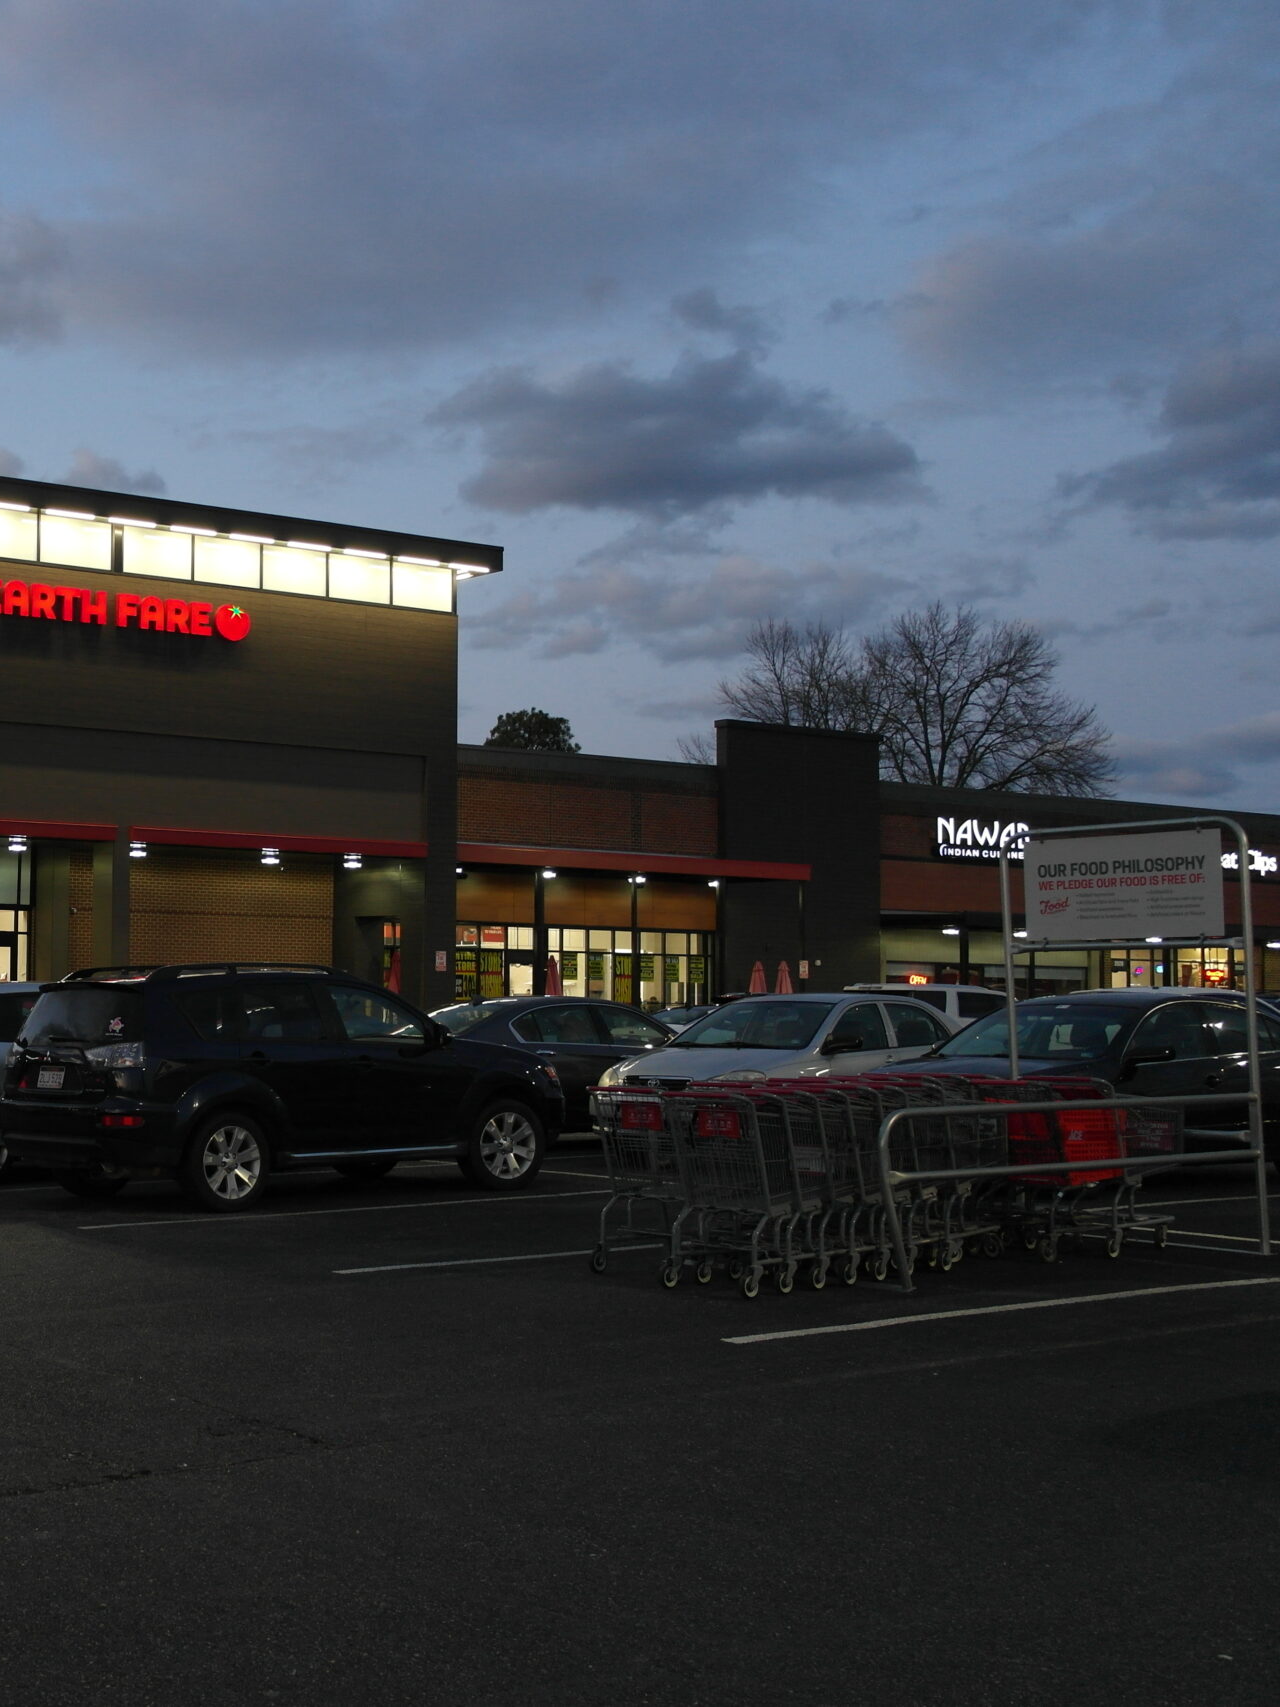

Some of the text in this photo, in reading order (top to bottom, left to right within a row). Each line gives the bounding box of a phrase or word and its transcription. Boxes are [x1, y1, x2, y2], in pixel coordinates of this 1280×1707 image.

[116, 593, 213, 636] FARE
[943, 848, 1025, 860] INDIAN CUIINE
[1037, 855, 1206, 878] OUR FOOD PHILOSOPHY
[1039, 880, 1055, 891] WE
[1056, 879, 1094, 890] PLEDGE
[1096, 877, 1117, 888] OUR
[1120, 876, 1147, 888] FOOD
[1149, 875, 1160, 886] IS
[1161, 874, 1187, 885] FREE
